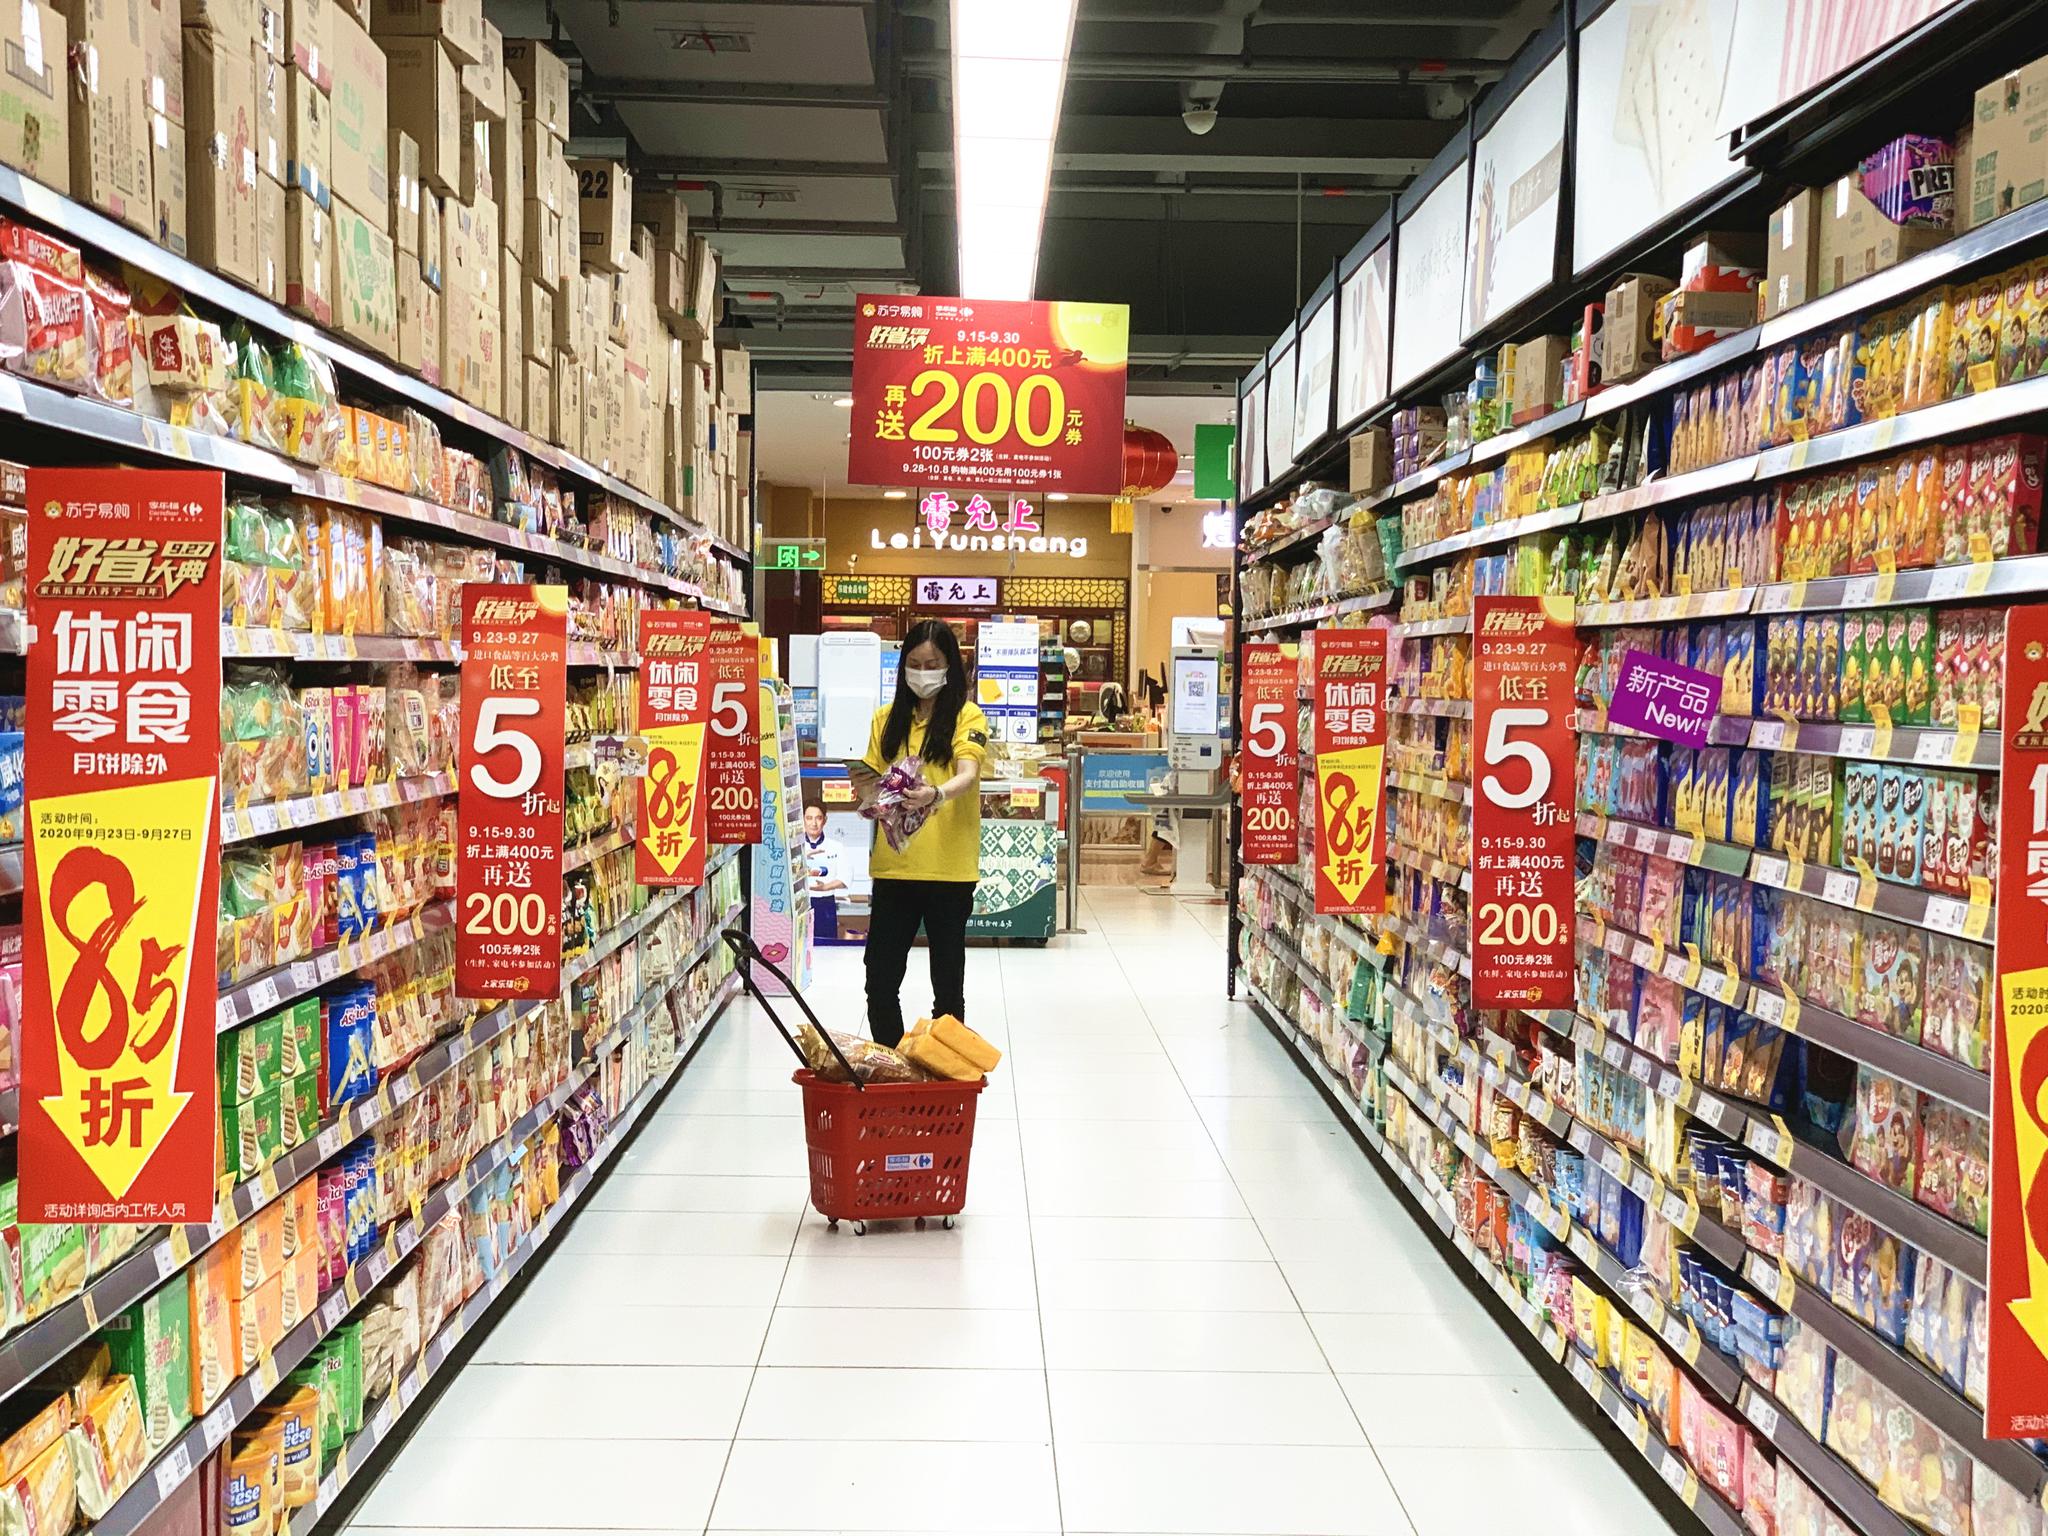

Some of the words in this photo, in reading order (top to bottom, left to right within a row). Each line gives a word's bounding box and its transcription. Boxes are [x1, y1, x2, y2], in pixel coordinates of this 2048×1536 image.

[877, 304, 923, 318] 苏宁易购
[957, 330, 1020, 344] 9.15-9.30
[923, 345, 1052, 370] 折上满400元
[875, 385, 907, 441] 再送
[909, 370, 1065, 447] 200
[1065, 409, 1083, 446] 元券
[912, 445, 994, 463] 100元券2张
[902, 463, 949, 474] 9.28-10.8
[951, 464, 1062, 479] 购物满400元用100元券1张
[65, 502, 130, 520] 苏宁易购
[920, 491, 1040, 533] 雷允上
[871, 528, 920, 550] Lei
[929, 530, 1088, 558] Yunshang
[40, 537, 159, 583] 好省
[168, 543, 213, 556] 9.27
[147, 559, 208, 597] 大典
[40, 586, 159, 596] 家乐福加入苏宁一周年
[923, 581, 991, 602] 雷允上
[52, 610, 193, 676] 休闲
[473, 631, 539, 644] 9.23-9.27
[1482, 643, 1547, 655] 9.23-9.27
[473, 649, 559, 662] 进口食品等百大分类
[1483, 660, 1568, 673] 进口食品等百大分类
[488, 663, 541, 690] 低至
[648, 660, 699, 686] 休闲
[718, 664, 746, 680] 低至
[648, 686, 698, 711] 零食
[1256, 685, 1284, 701] 低至
[1324, 682, 1376, 707] 休闲
[1497, 675, 1549, 701] 低至
[1626, 664, 1711, 715] 新产品
[52, 680, 192, 744] 零食
[711, 682, 748, 737] 5
[1324, 708, 1376, 733] 零食
[1644, 701, 1702, 736] New!
[1248, 703, 1286, 758] 5
[470, 697, 542, 799] 5
[1481, 708, 1553, 810] 5
[73, 752, 168, 776] 月饼除外
[710, 786, 754, 811] 200
[1246, 807, 1290, 831] 200
[39, 828, 192, 841] 2020年9月23日-9月27日
[469, 826, 535, 839] 9.15-9.30
[656, 831, 683, 857] 折
[1481, 837, 1546, 849] 9.15-9.30
[466, 844, 554, 860] 折上满400元
[1478, 855, 1565, 870] 折上满400元
[482, 861, 533, 888] 再送
[1336, 858, 1363, 885] 折
[1494, 871, 1544, 898] 再送
[465, 892, 546, 936] 200
[1478, 902, 1558, 946] 200
[479, 943, 541, 956] 100元券2张
[1492, 954, 1553, 965] 100元券2张
[81, 1077, 154, 1149] 折
[44, 1202, 186, 1219] 活动详询店内工作人员
